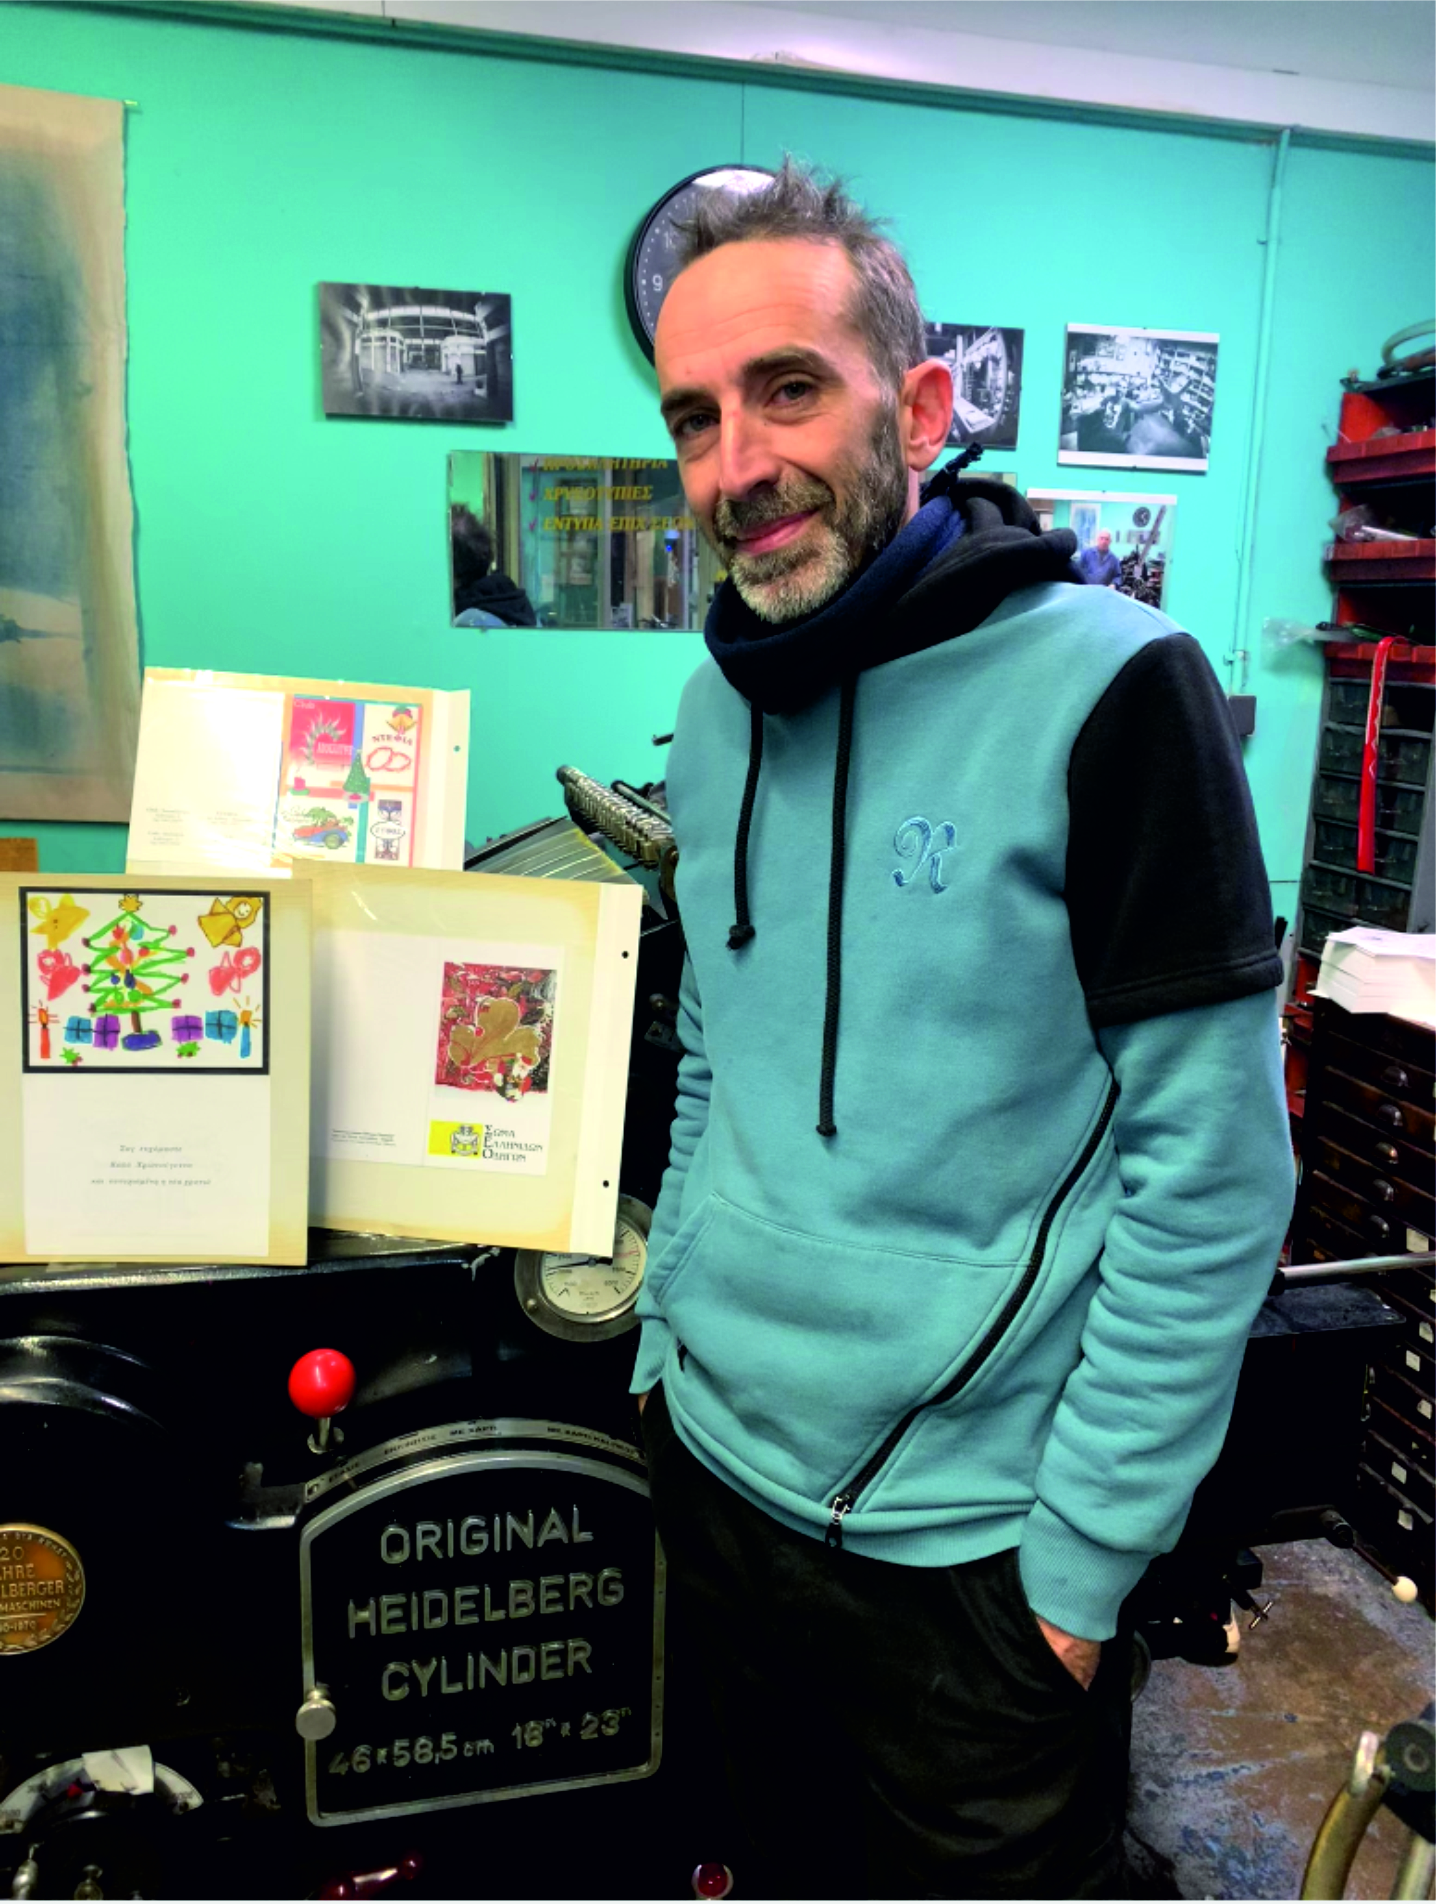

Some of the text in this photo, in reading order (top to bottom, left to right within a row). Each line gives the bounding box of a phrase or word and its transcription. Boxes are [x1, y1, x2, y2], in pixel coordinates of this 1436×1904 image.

[652, 274, 663, 291] 9
[380, 1504, 594, 1564] ORIGINAL
[347, 1567, 625, 1639] HEIDELBERG
[381, 1637, 593, 1701] CYLINDER
